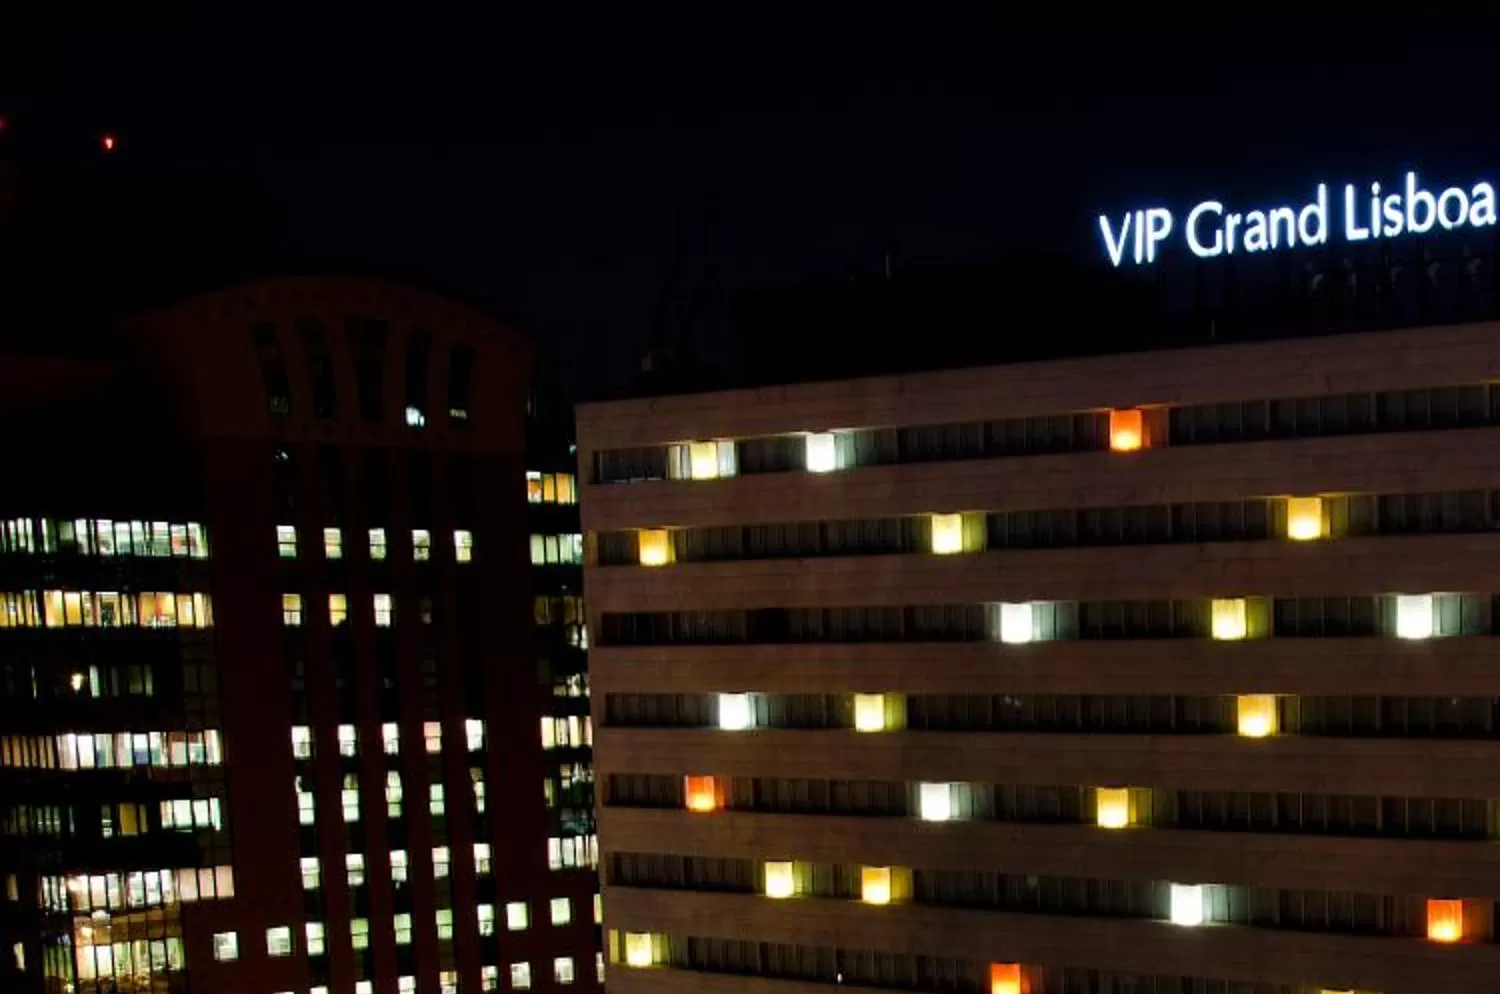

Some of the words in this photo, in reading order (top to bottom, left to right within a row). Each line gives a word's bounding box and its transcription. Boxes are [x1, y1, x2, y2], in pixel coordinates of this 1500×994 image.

[1098, 206, 1174, 267] VIP
[1185, 182, 1328, 258] Grand
[1343, 171, 1497, 242] Lisboa
